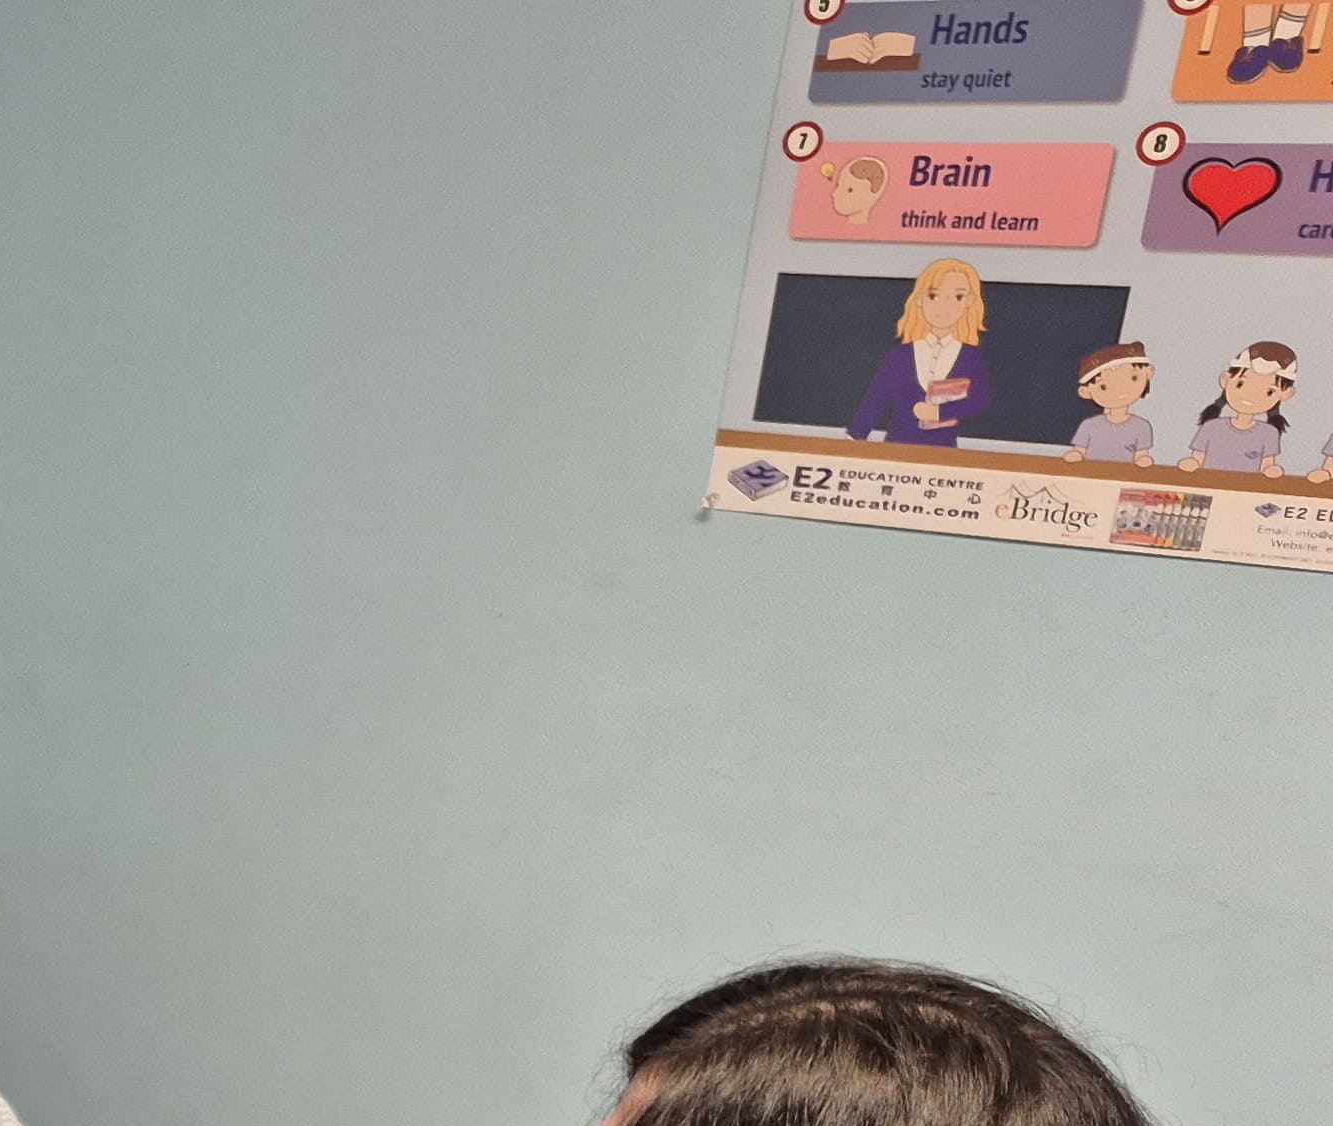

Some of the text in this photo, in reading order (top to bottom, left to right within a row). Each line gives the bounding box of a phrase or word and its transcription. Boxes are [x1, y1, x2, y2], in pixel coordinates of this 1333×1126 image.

[930, 12, 1029, 45] Hands
[920, 69, 1012, 93] stay quiet
[798, 133, 808, 150] 7
[1153, 134, 1168, 153] 8
[909, 155, 992, 187] Brain
[900, 210, 1039, 231] think and learn
[1298, 223, 1333, 239] car
[792, 466, 985, 491] E2 EDUCATION CENTRE
[790, 491, 980, 520] E2education.com
[995, 497, 1098, 533] eBridge
[1284, 506, 1308, 520] E2
